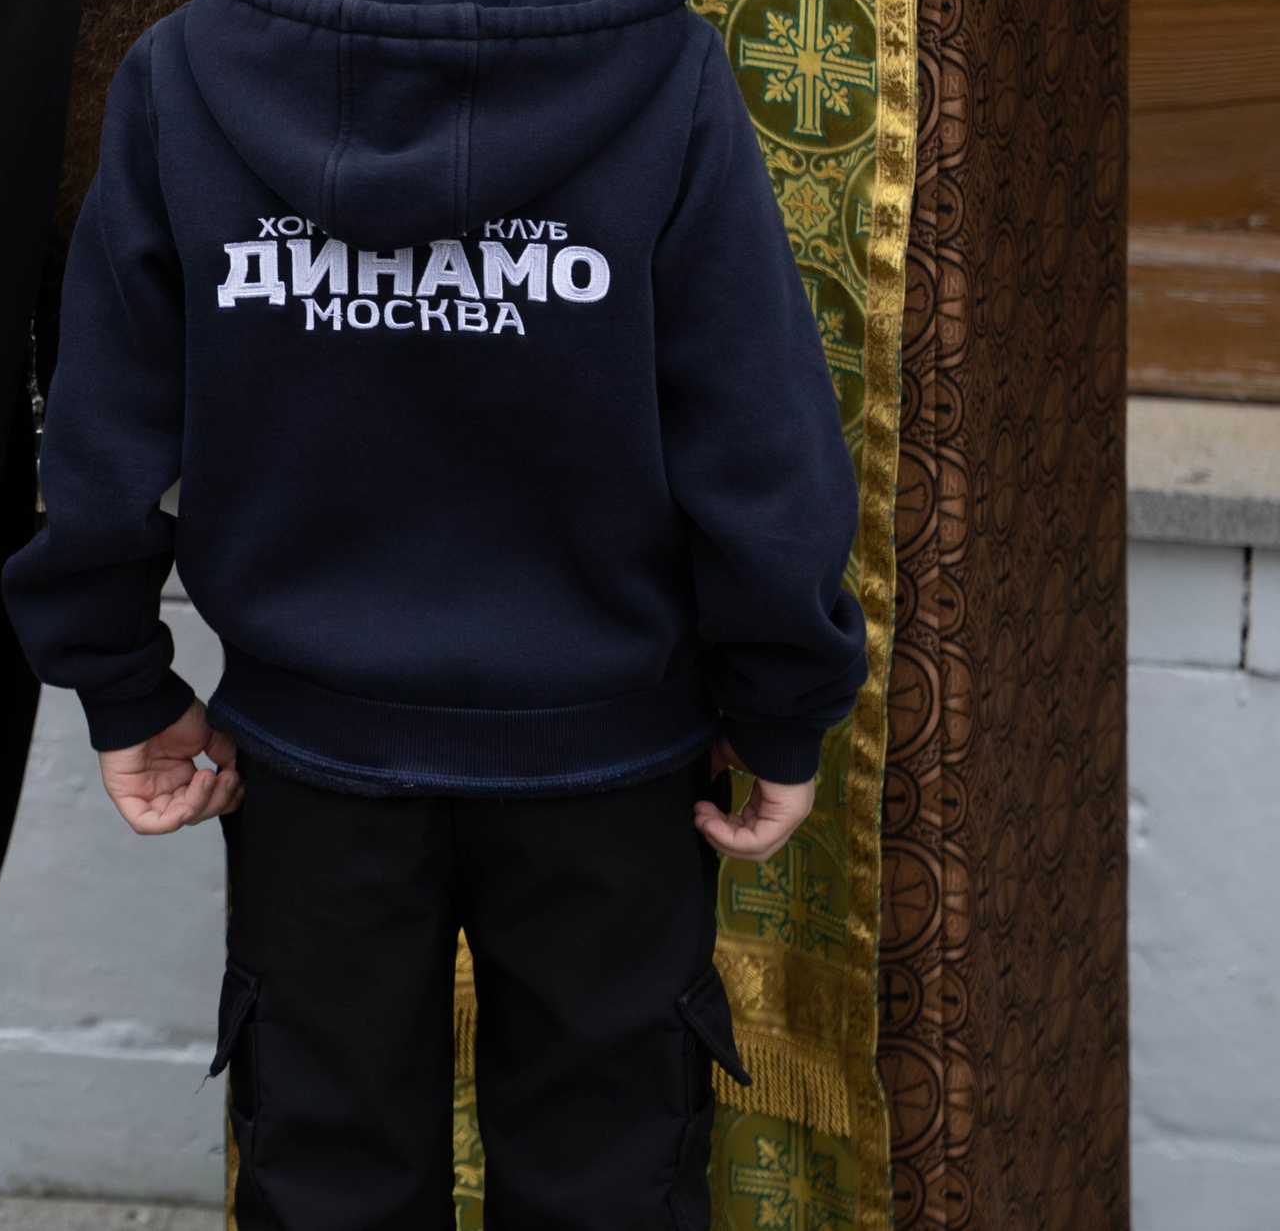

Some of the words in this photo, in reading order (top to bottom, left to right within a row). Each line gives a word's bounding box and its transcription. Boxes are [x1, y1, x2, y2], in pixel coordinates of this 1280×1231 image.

[483, 218, 569, 241] КЛУБ
[218, 239, 611, 308] ДИНАМО
[301, 298, 526, 336] МОСКВА
